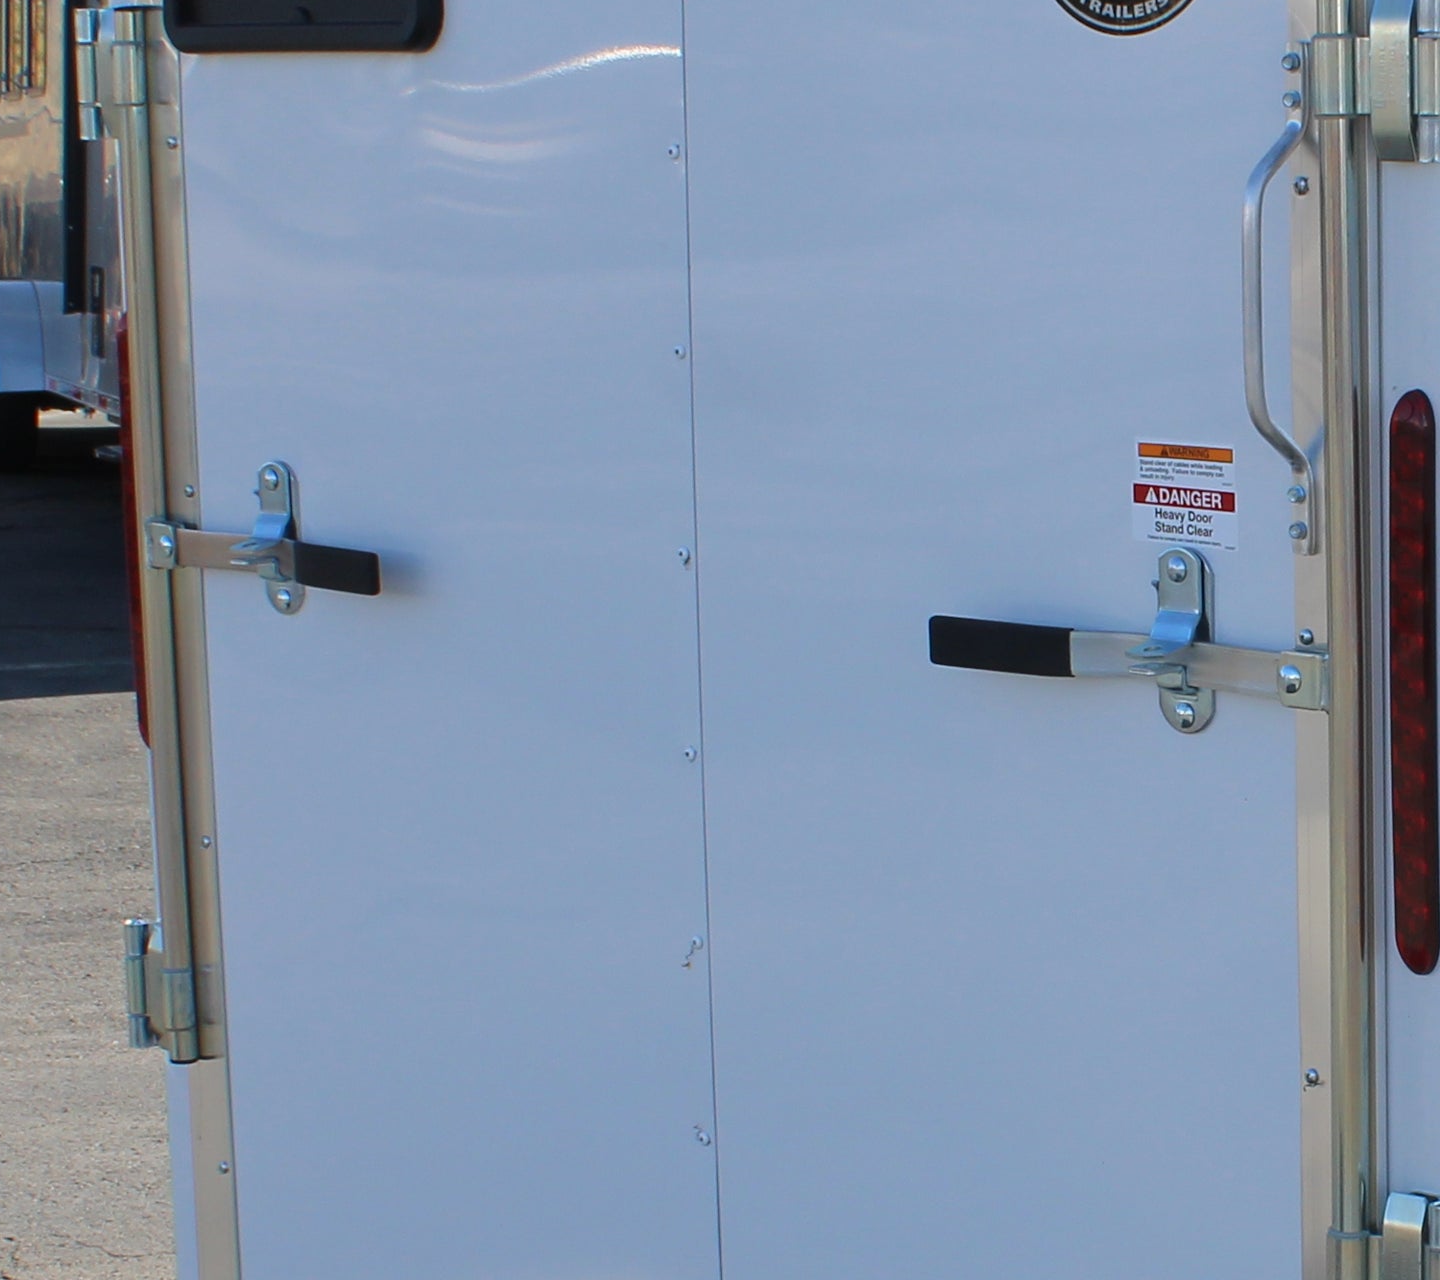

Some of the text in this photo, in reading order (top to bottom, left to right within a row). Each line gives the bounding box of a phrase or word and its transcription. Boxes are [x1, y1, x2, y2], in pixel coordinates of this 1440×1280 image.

[1168, 446, 1209, 459] WARNING
[1159, 487, 1222, 509] DANGER
[1155, 507, 1213, 524] Heavy Door
[1155, 521, 1213, 537] Stand Clear
